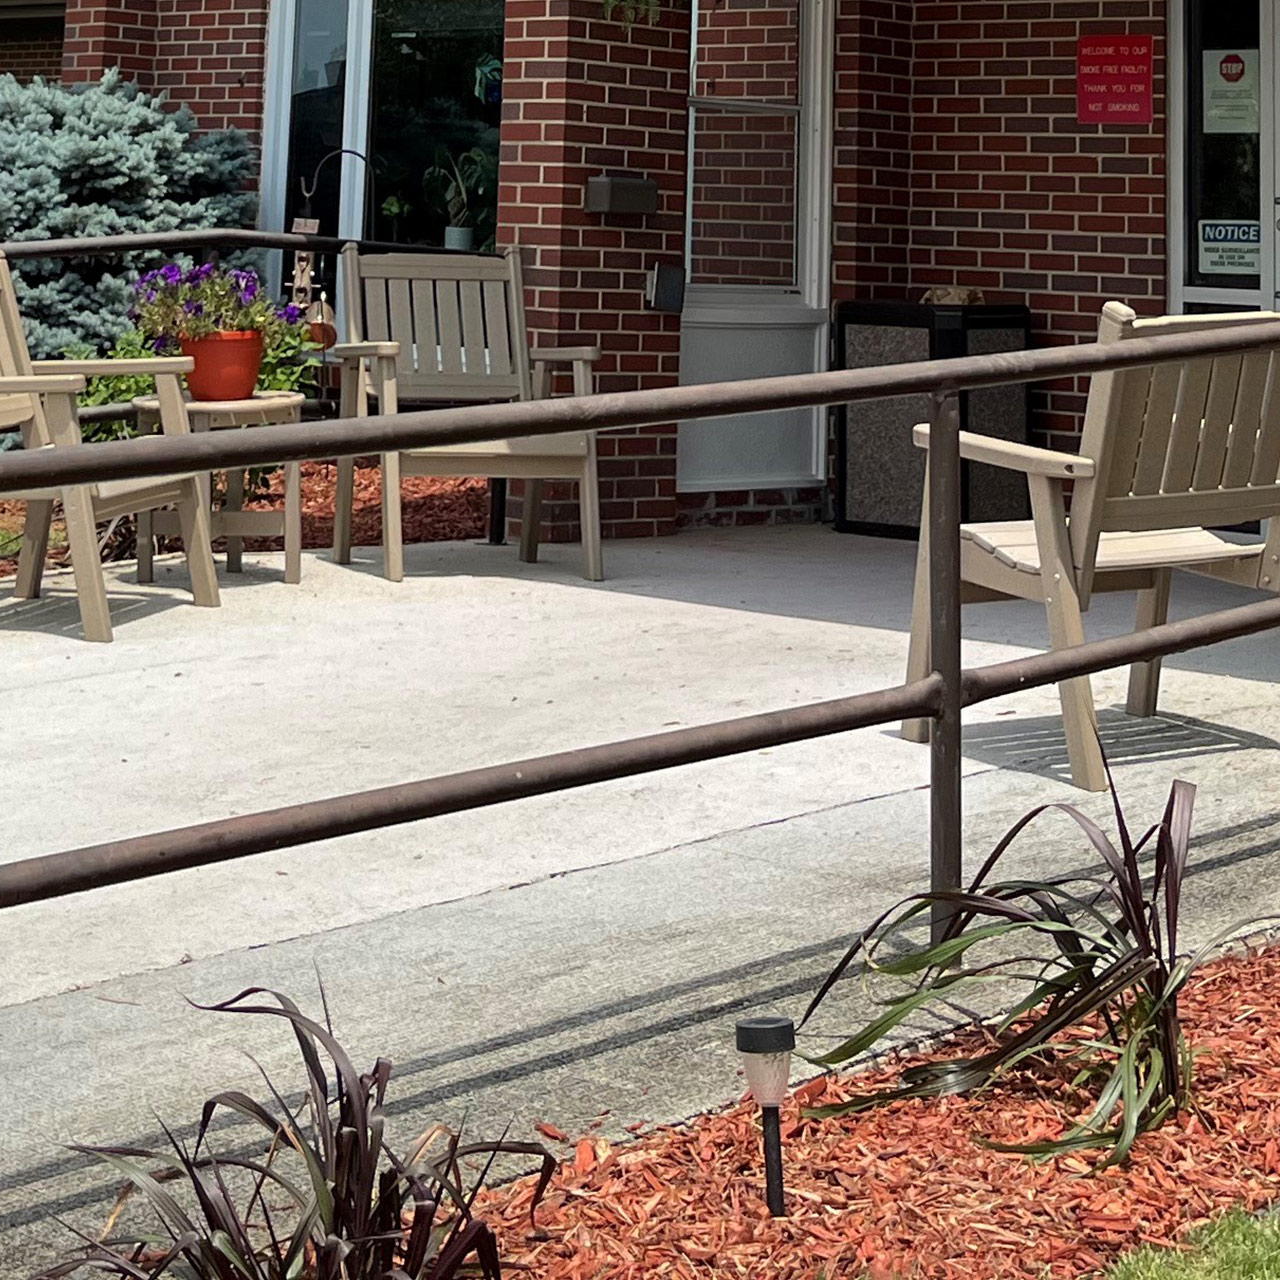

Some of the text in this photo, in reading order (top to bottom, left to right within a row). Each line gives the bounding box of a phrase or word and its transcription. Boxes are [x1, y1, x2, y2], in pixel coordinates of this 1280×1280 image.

[1081, 46, 1147, 55] WELCOME TO OUR
[1080, 65, 1100, 74] SMOKE
[1102, 65, 1119, 74] FREE
[1222, 63, 1243, 74] STOP
[1084, 84, 1145, 93] THANK YOU FOR
[1088, 103, 1140, 112] NOT SMOKING
[1204, 226, 1259, 240] NOTICE
